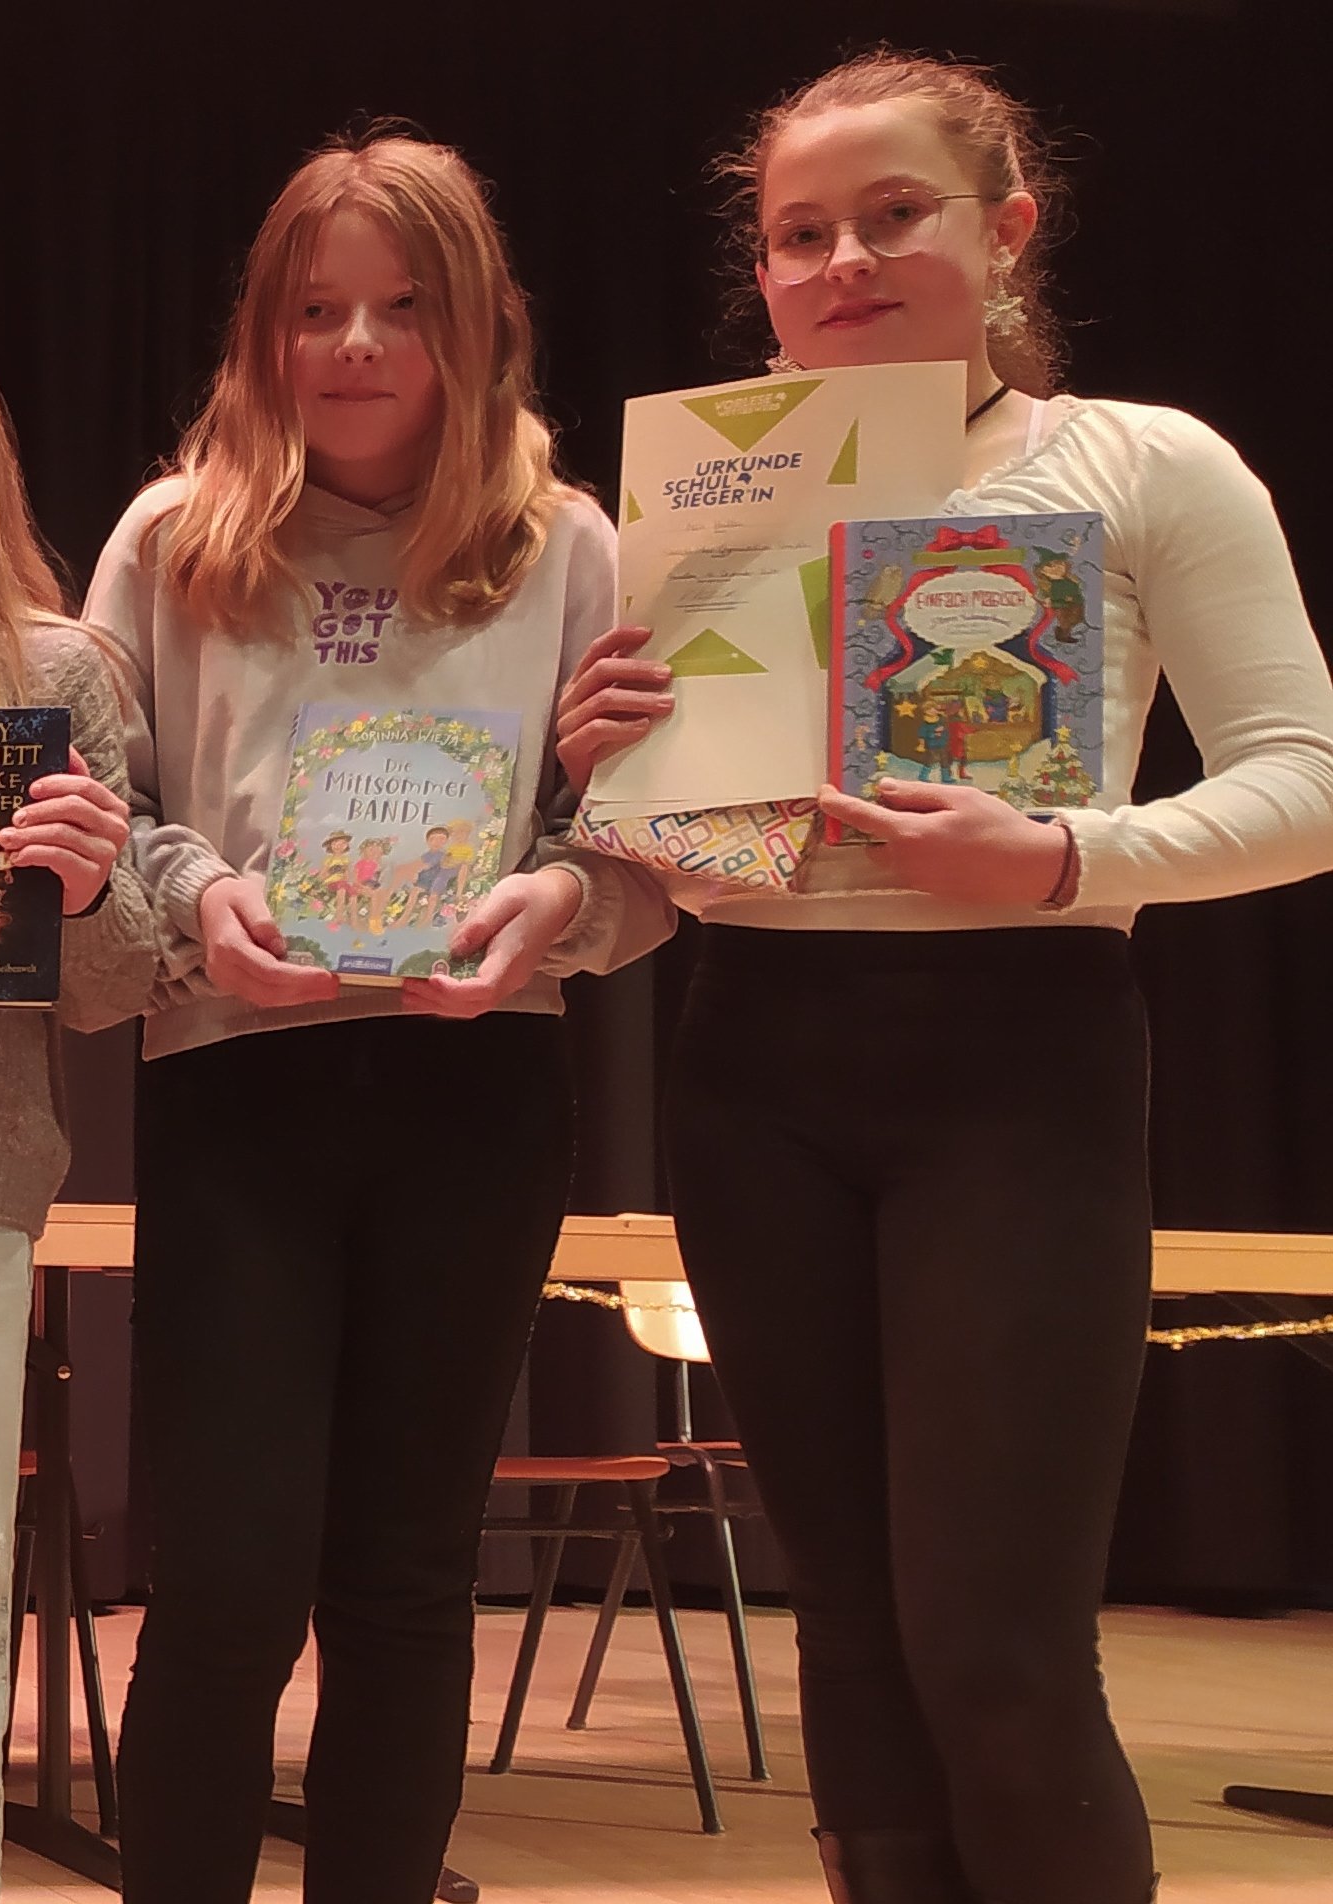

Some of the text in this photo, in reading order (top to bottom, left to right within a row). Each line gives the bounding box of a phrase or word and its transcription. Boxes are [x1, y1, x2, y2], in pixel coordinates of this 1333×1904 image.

[696, 453, 802, 476] URKUNDE
[663, 475, 731, 495] SCHUL
[314, 581, 398, 611] YOU
[312, 612, 393, 638] GOT
[314, 641, 379, 664] THIS
[352, 730, 409, 743] CORINNA
[385, 757, 412, 774] Die
[324, 771, 469, 799] Mittsommer
[348, 798, 436, 826] BANDE
